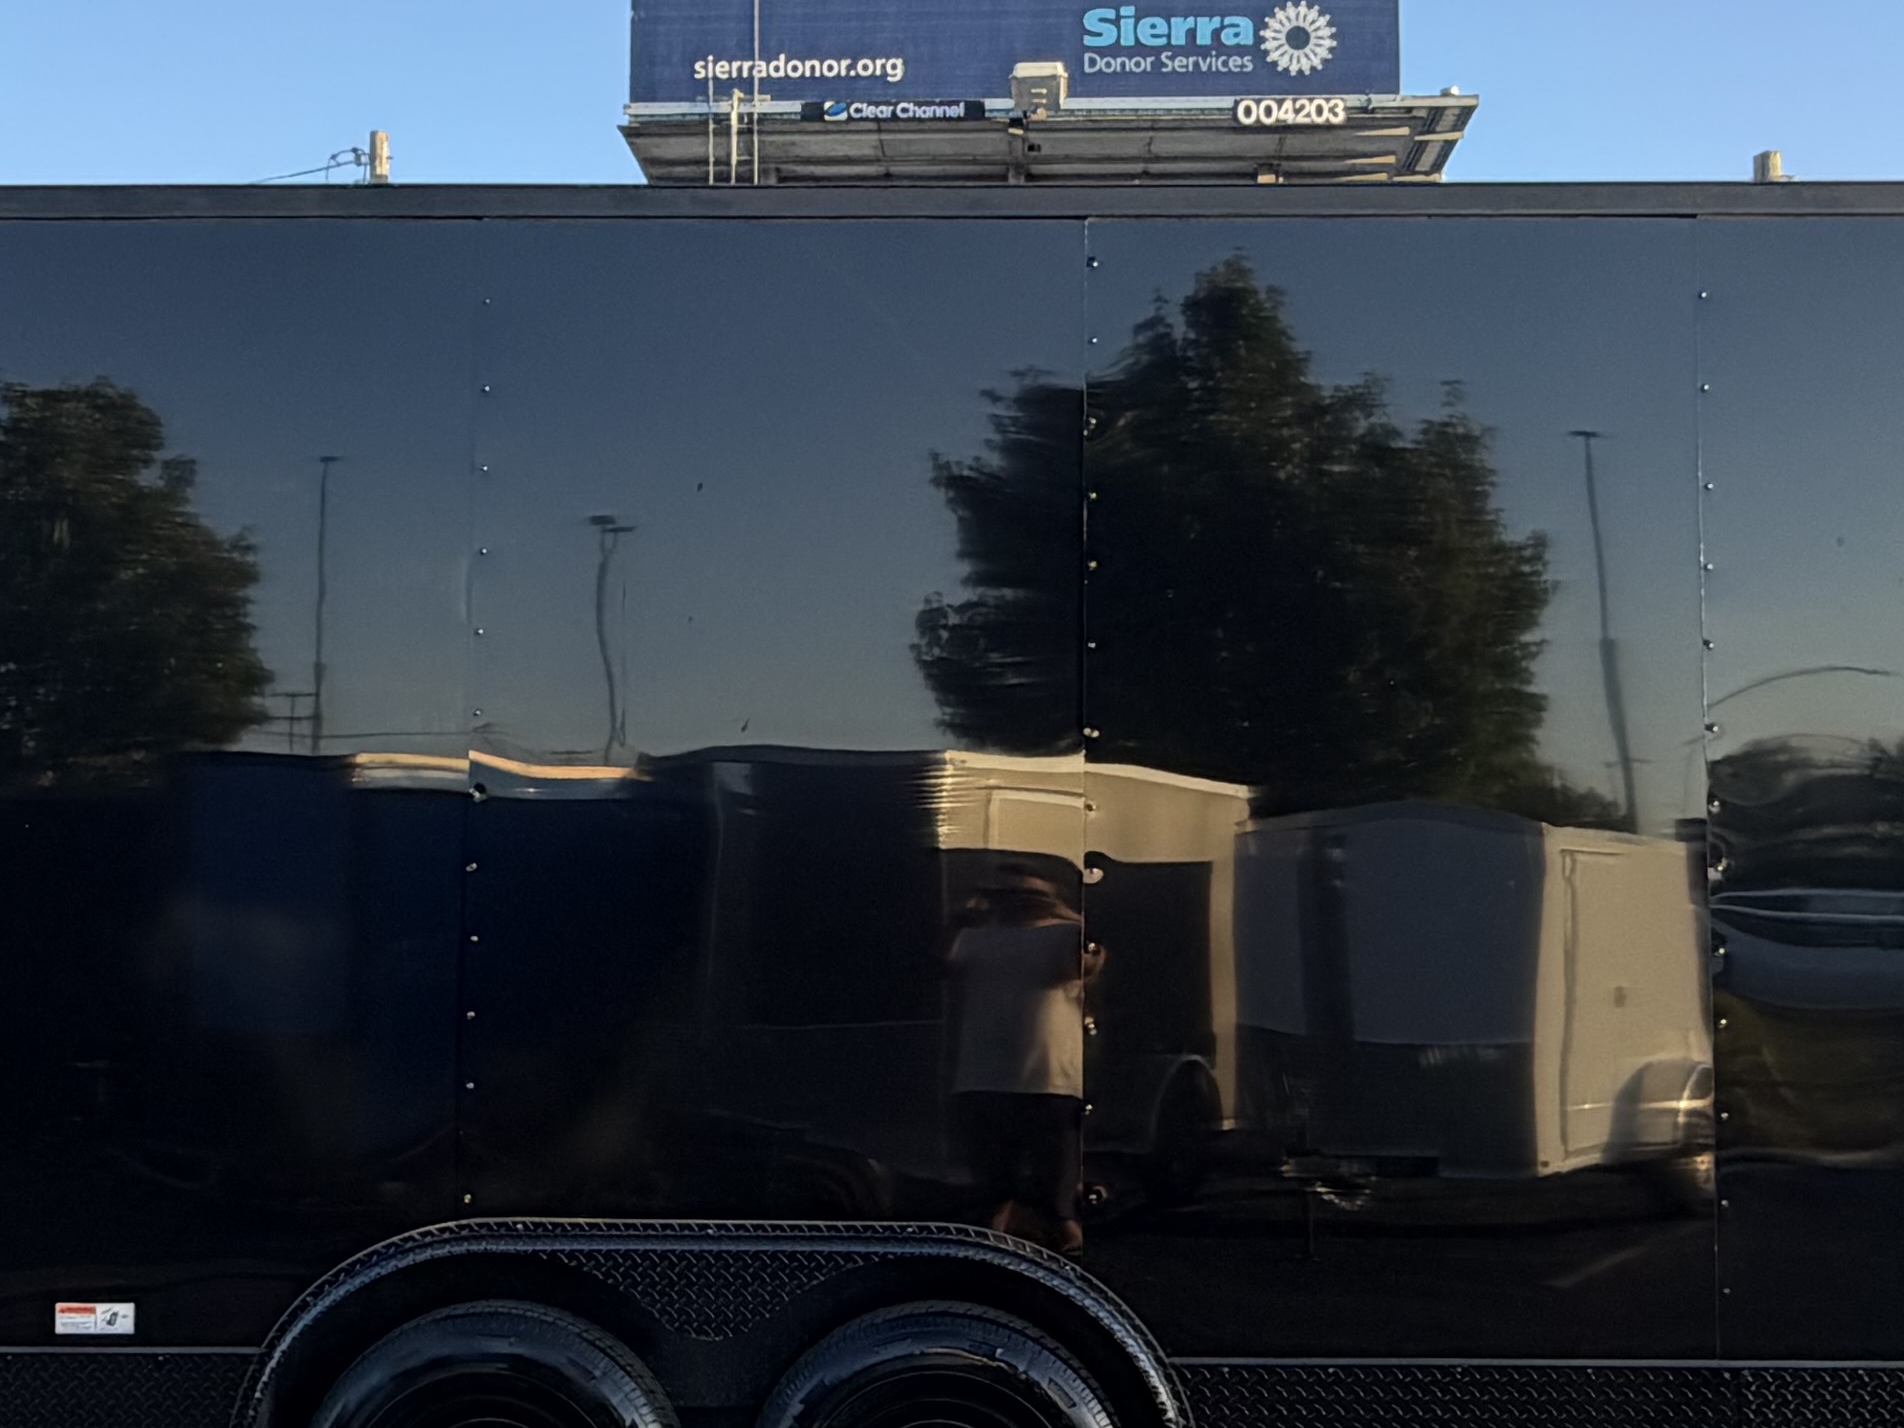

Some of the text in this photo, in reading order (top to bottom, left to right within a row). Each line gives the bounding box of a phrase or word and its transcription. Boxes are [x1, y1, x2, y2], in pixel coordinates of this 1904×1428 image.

[1083, 5, 1254, 47] Sierra
[694, 54, 904, 82] sierradonor.org
[1083, 50, 1253, 73] Donor Services
[849, 101, 966, 119] Clear Channel
[1237, 98, 1346, 125] 004203
